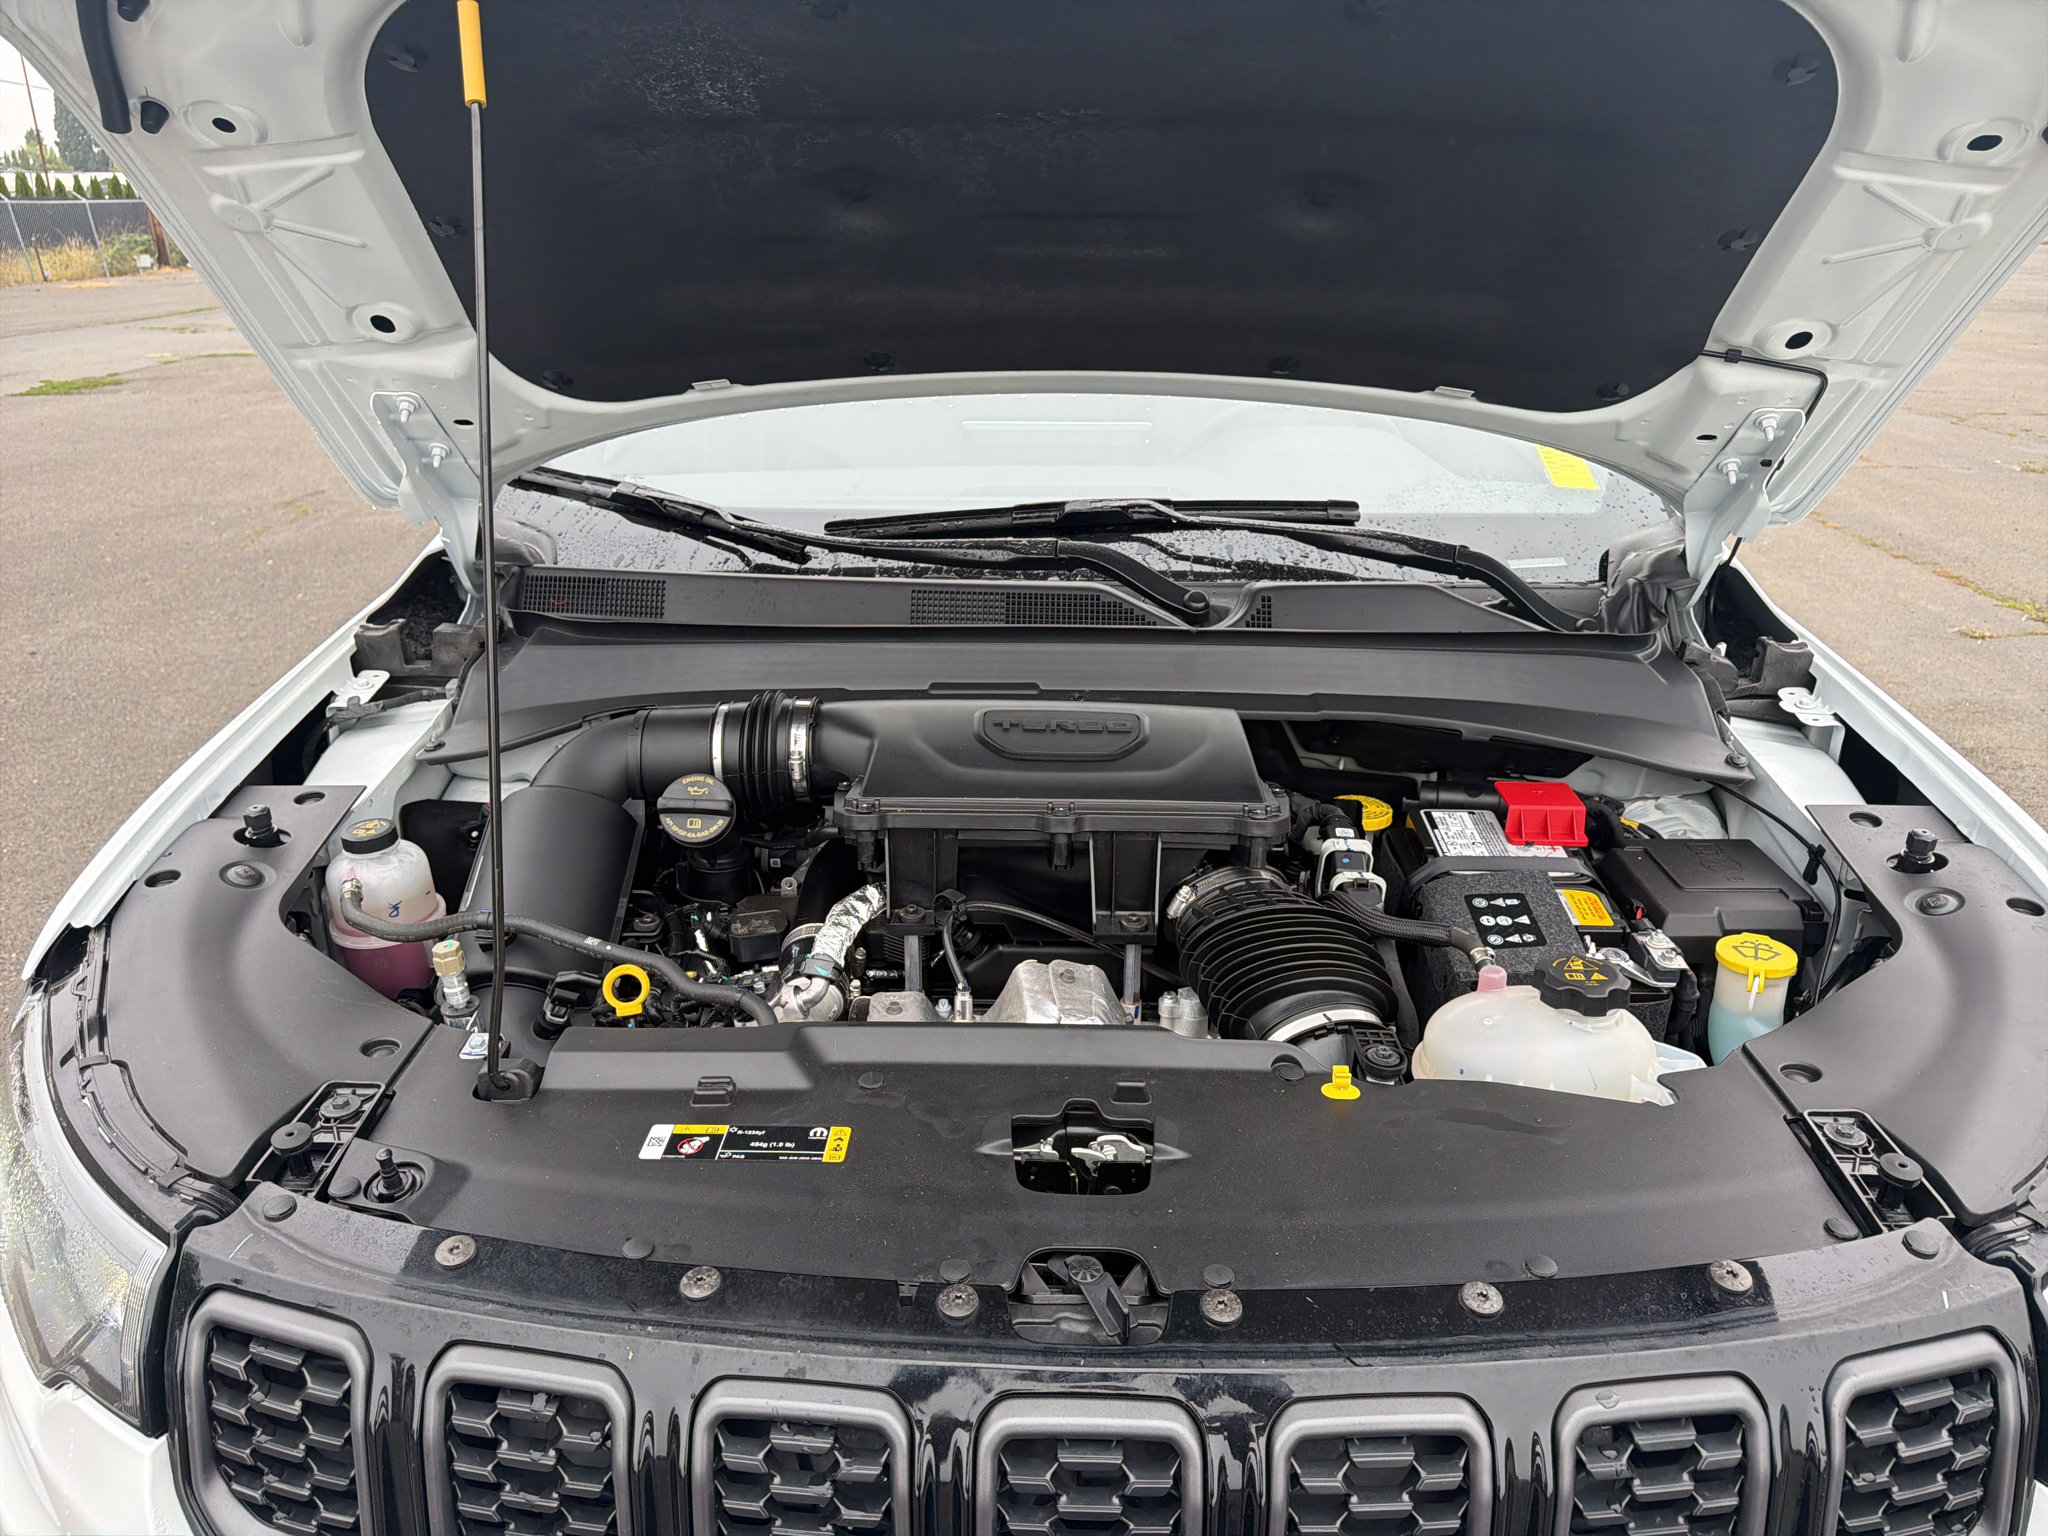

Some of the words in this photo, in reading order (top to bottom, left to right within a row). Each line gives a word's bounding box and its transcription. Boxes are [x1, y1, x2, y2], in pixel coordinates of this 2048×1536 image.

[993, 718, 1132, 732] TURBO
[682, 776, 704, 785] ENGINE
[705, 777, 715, 786] OIL
[749, 1141, 768, 1149] 454g
[769, 1141, 784, 1149] (1.0
[785, 1141, 796, 1149] lb)
